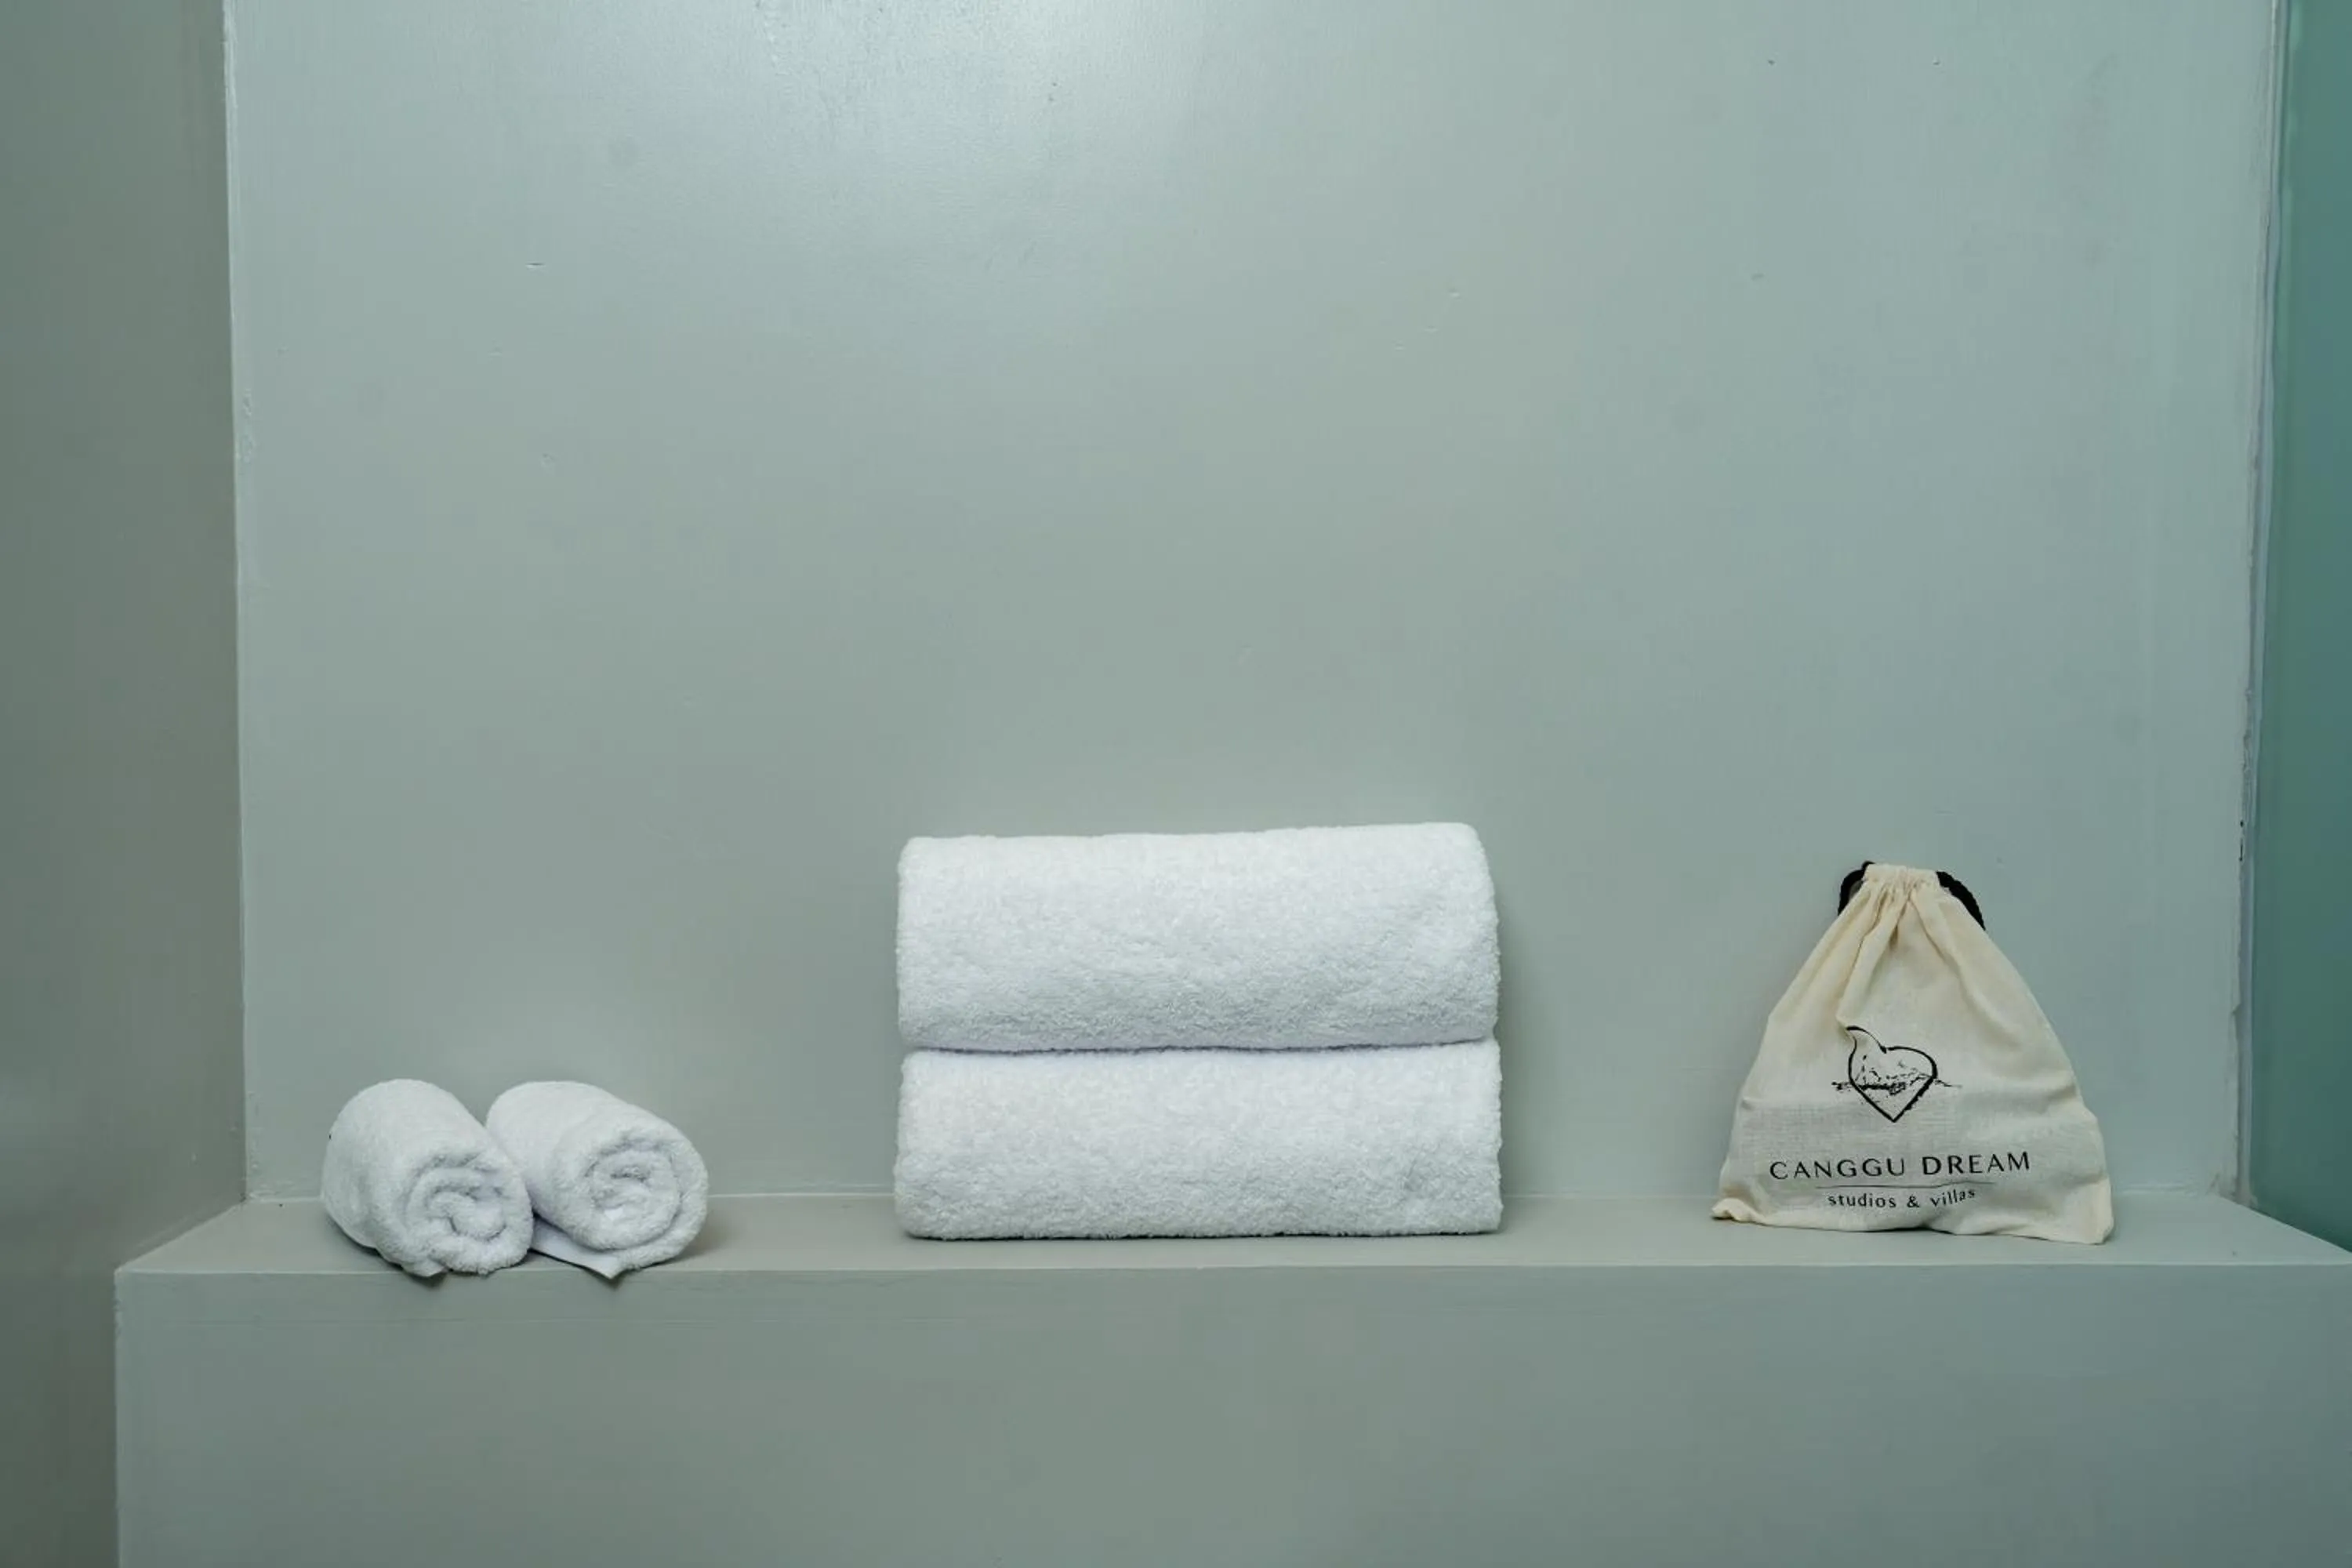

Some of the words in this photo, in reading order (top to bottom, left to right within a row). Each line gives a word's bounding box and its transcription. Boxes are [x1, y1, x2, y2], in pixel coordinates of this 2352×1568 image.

[1769, 1158, 1905, 1180] CANGGU
[1922, 1152, 2031, 1175] DREAM
[1828, 1192, 1896, 1209] studios
[1906, 1196, 1920, 1208] &
[1929, 1189, 1976, 1207] villas
